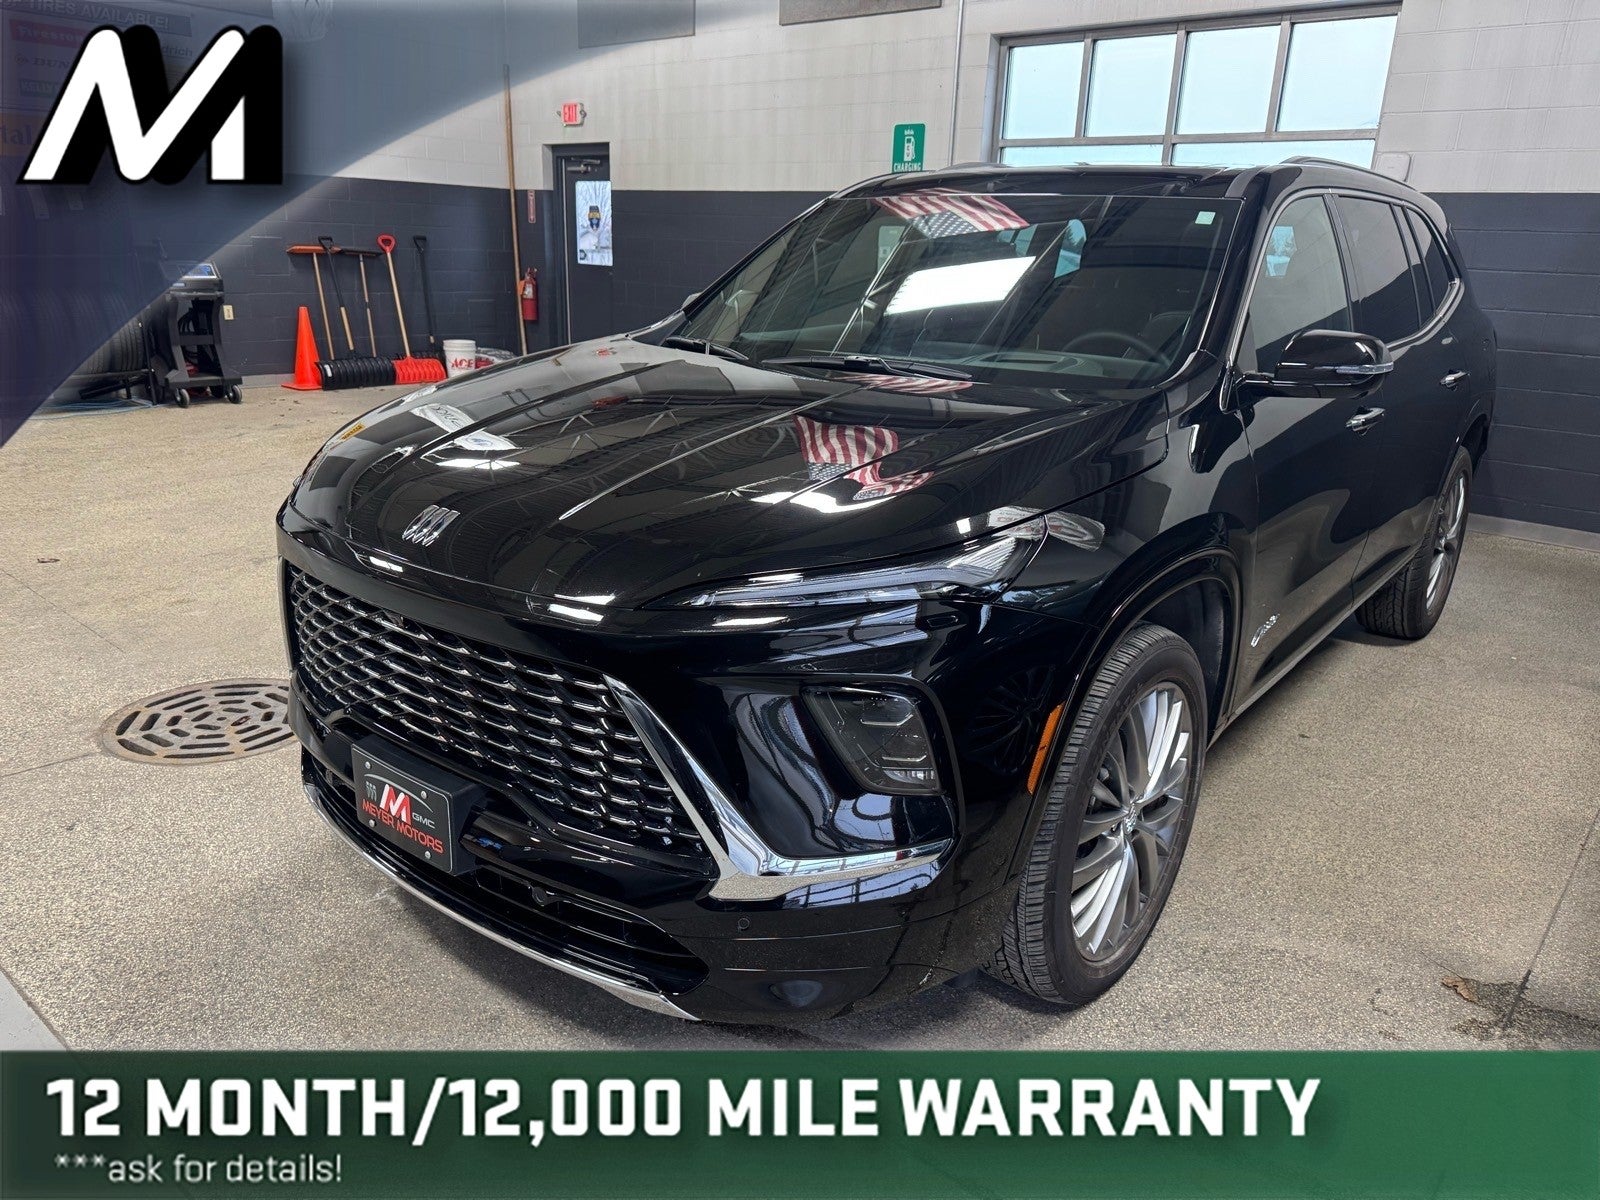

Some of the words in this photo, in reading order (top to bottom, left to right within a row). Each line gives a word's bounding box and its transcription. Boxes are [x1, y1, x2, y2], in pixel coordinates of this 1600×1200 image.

[81, 5, 169, 29] AVAILABLE!
[893, 162, 922, 172] CHARGING
[451, 358, 474, 368] ACE
[362, 798, 395, 829] MEYER
[396, 819, 445, 855] MOTORS
[411, 812, 436, 829] GMC
